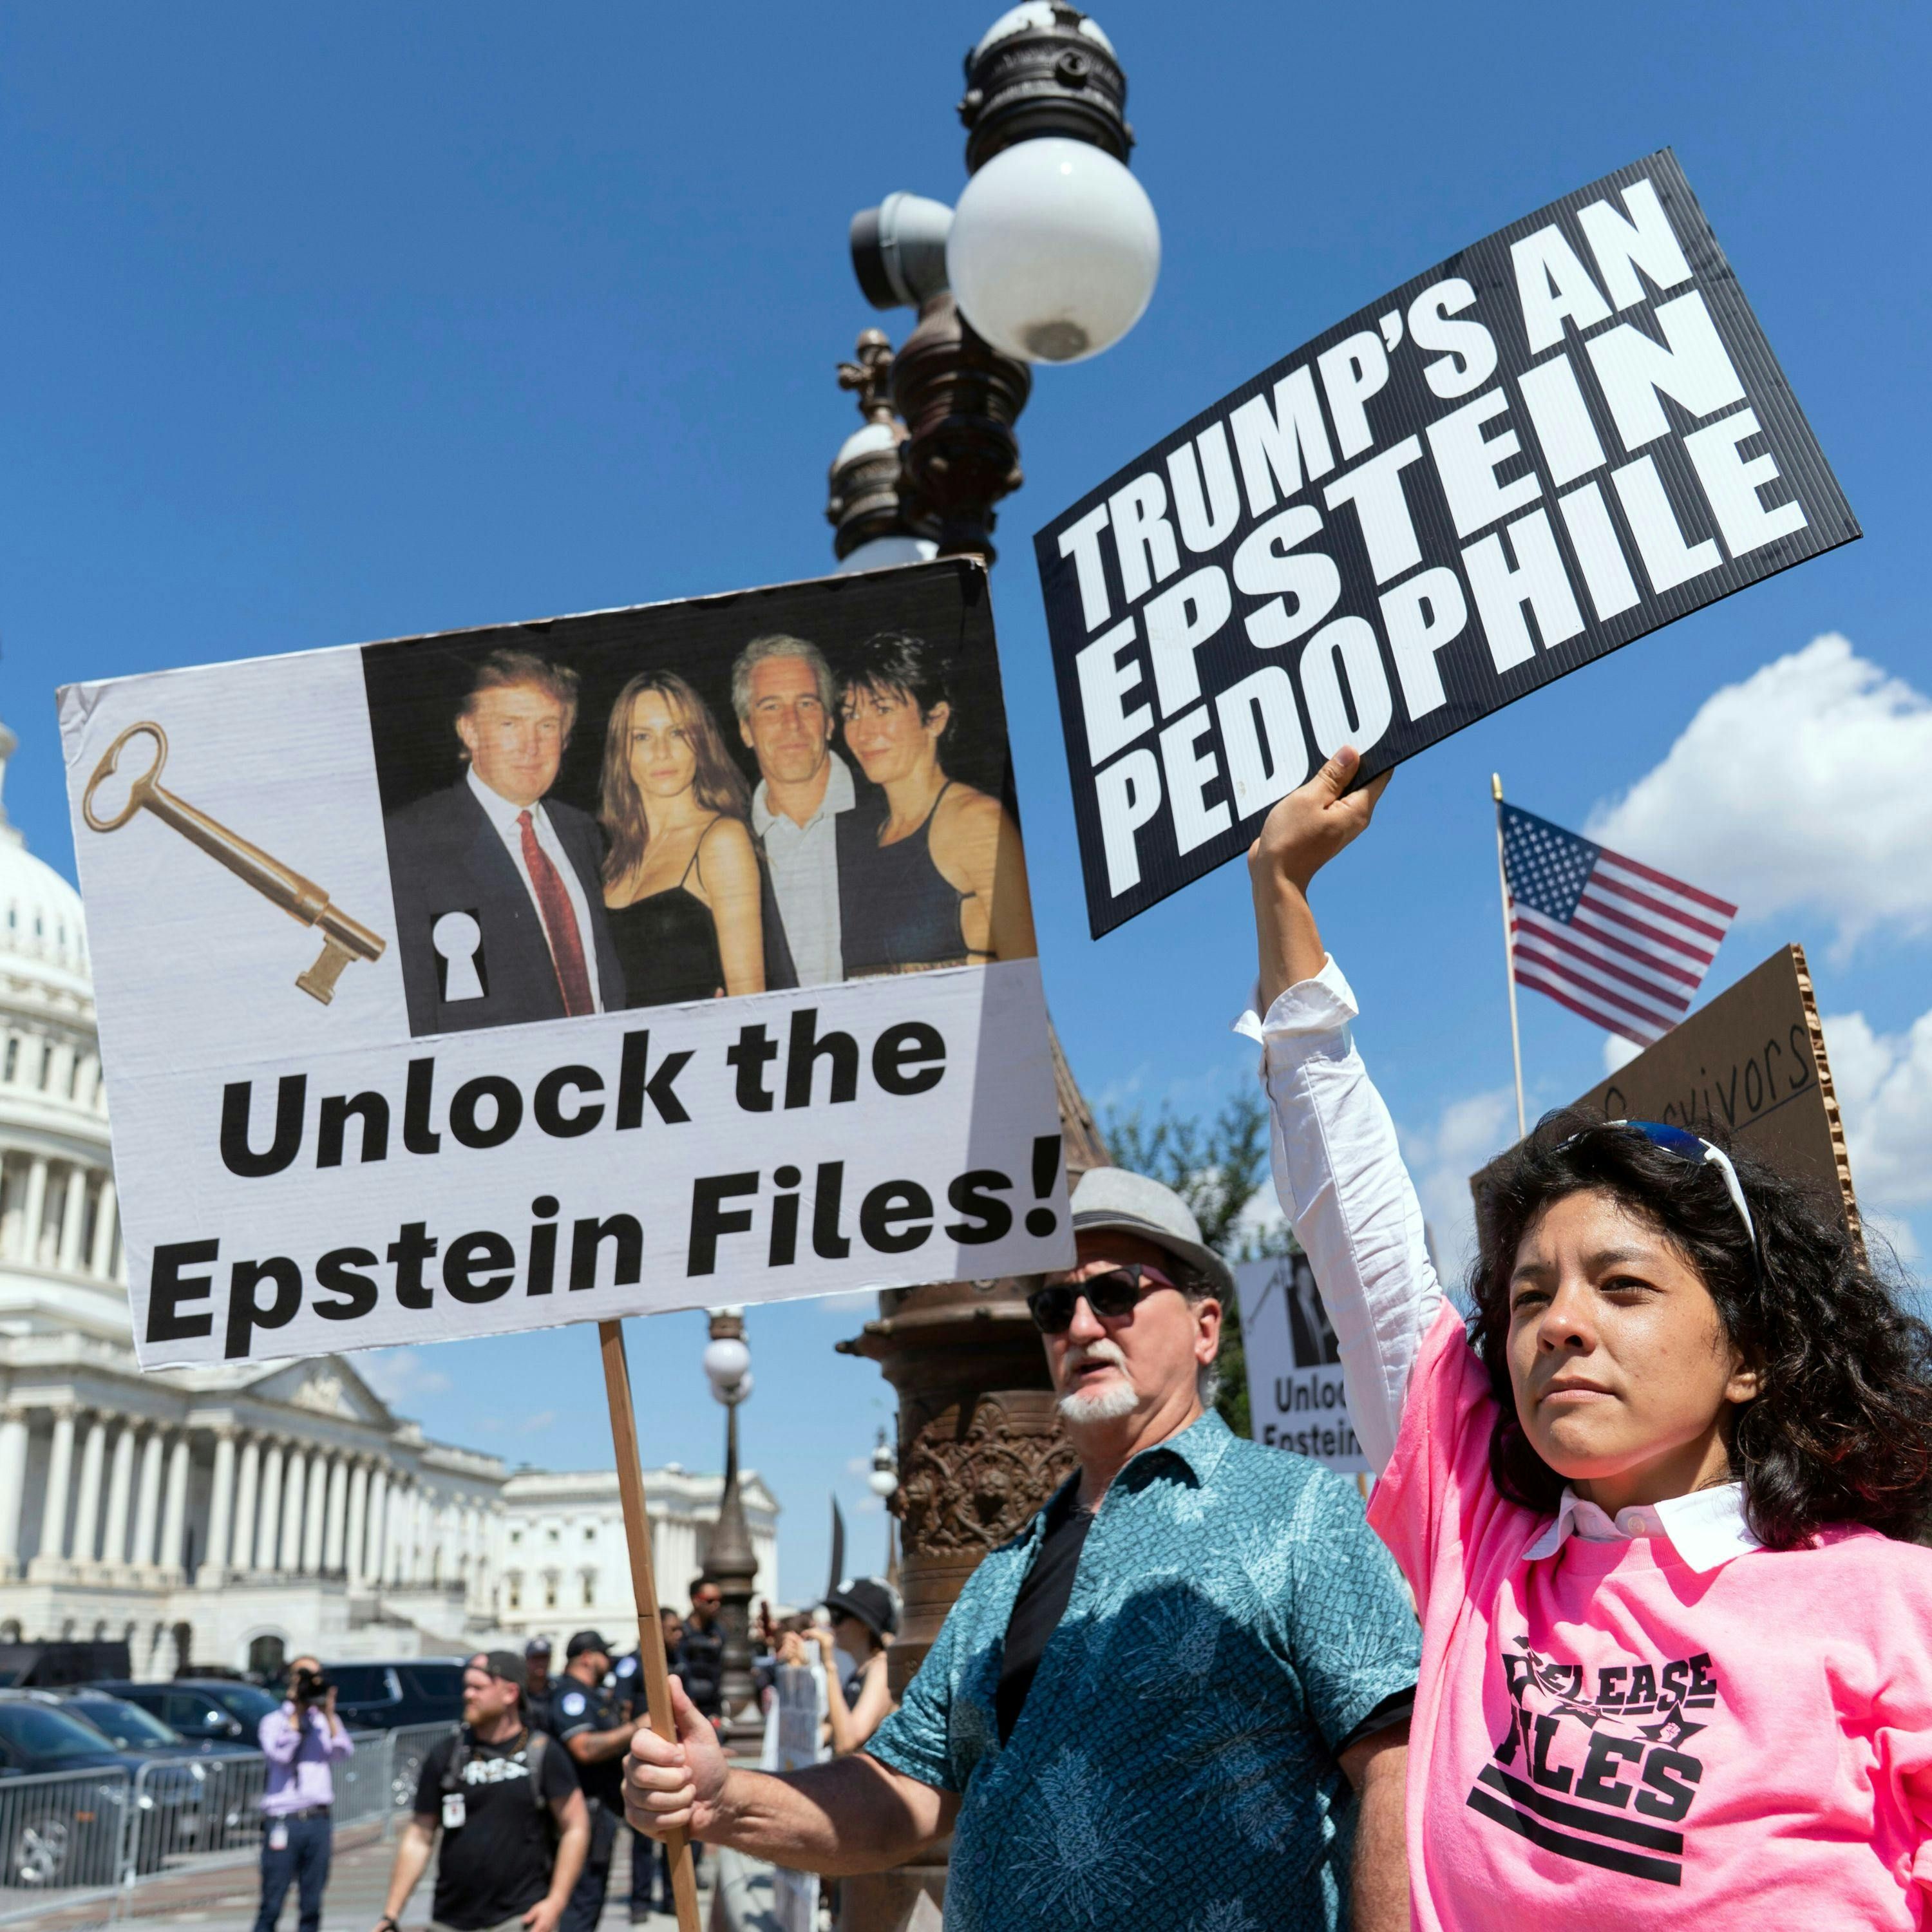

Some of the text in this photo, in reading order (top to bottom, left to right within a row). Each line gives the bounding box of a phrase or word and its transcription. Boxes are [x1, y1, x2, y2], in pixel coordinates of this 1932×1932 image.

[1057, 178, 1694, 632] TRUMP'S AN
[1075, 289, 1747, 767] EPSTEIN
[1095, 406, 1808, 898] PEDOPHILE
[220, 1009, 947, 1178] Unlock the
[1605, 1024, 1810, 1128] rvivors
[145, 1135, 1062, 1359] Epstein Files!
[1276, 1372, 1347, 1412] Unlo
